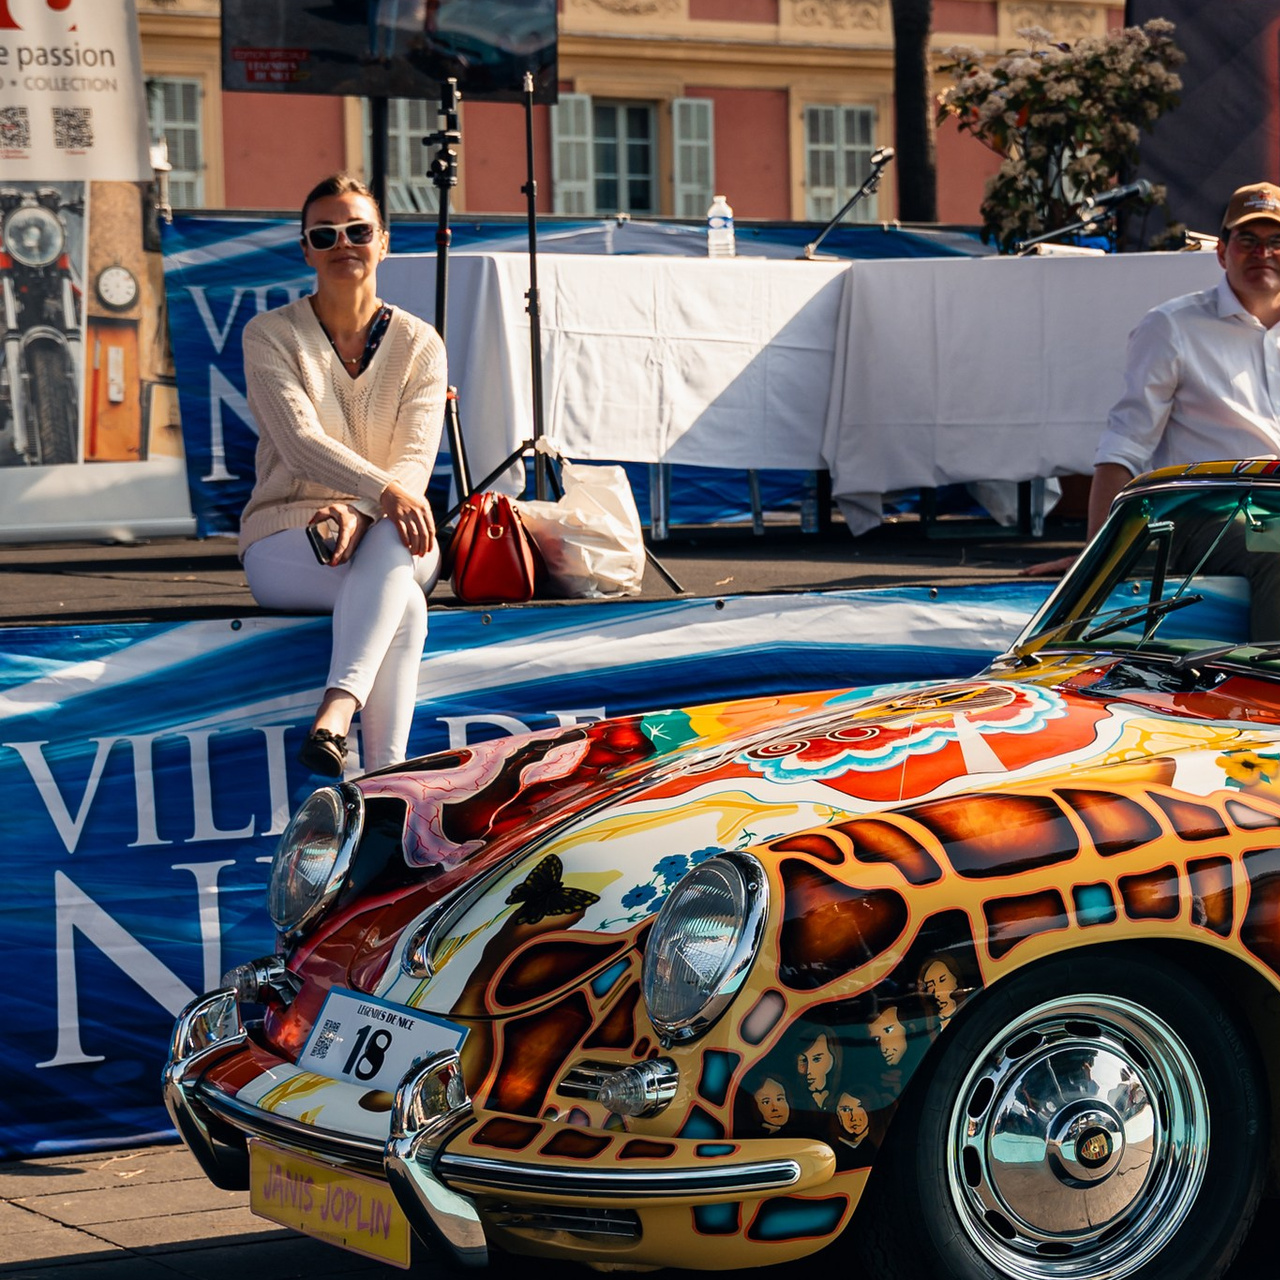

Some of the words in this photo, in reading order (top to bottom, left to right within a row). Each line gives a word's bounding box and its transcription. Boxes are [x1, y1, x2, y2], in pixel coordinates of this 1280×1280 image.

[17, 41, 116, 72] passion
[24, 76, 119, 92] COLLECTION
[385, 1011, 398, 1025] DE
[397, 1016, 416, 1031] NICE
[342, 1024, 393, 1081] 18
[262, 1163, 314, 1213] JANIS
[319, 1183, 393, 1241] JOPLIN
